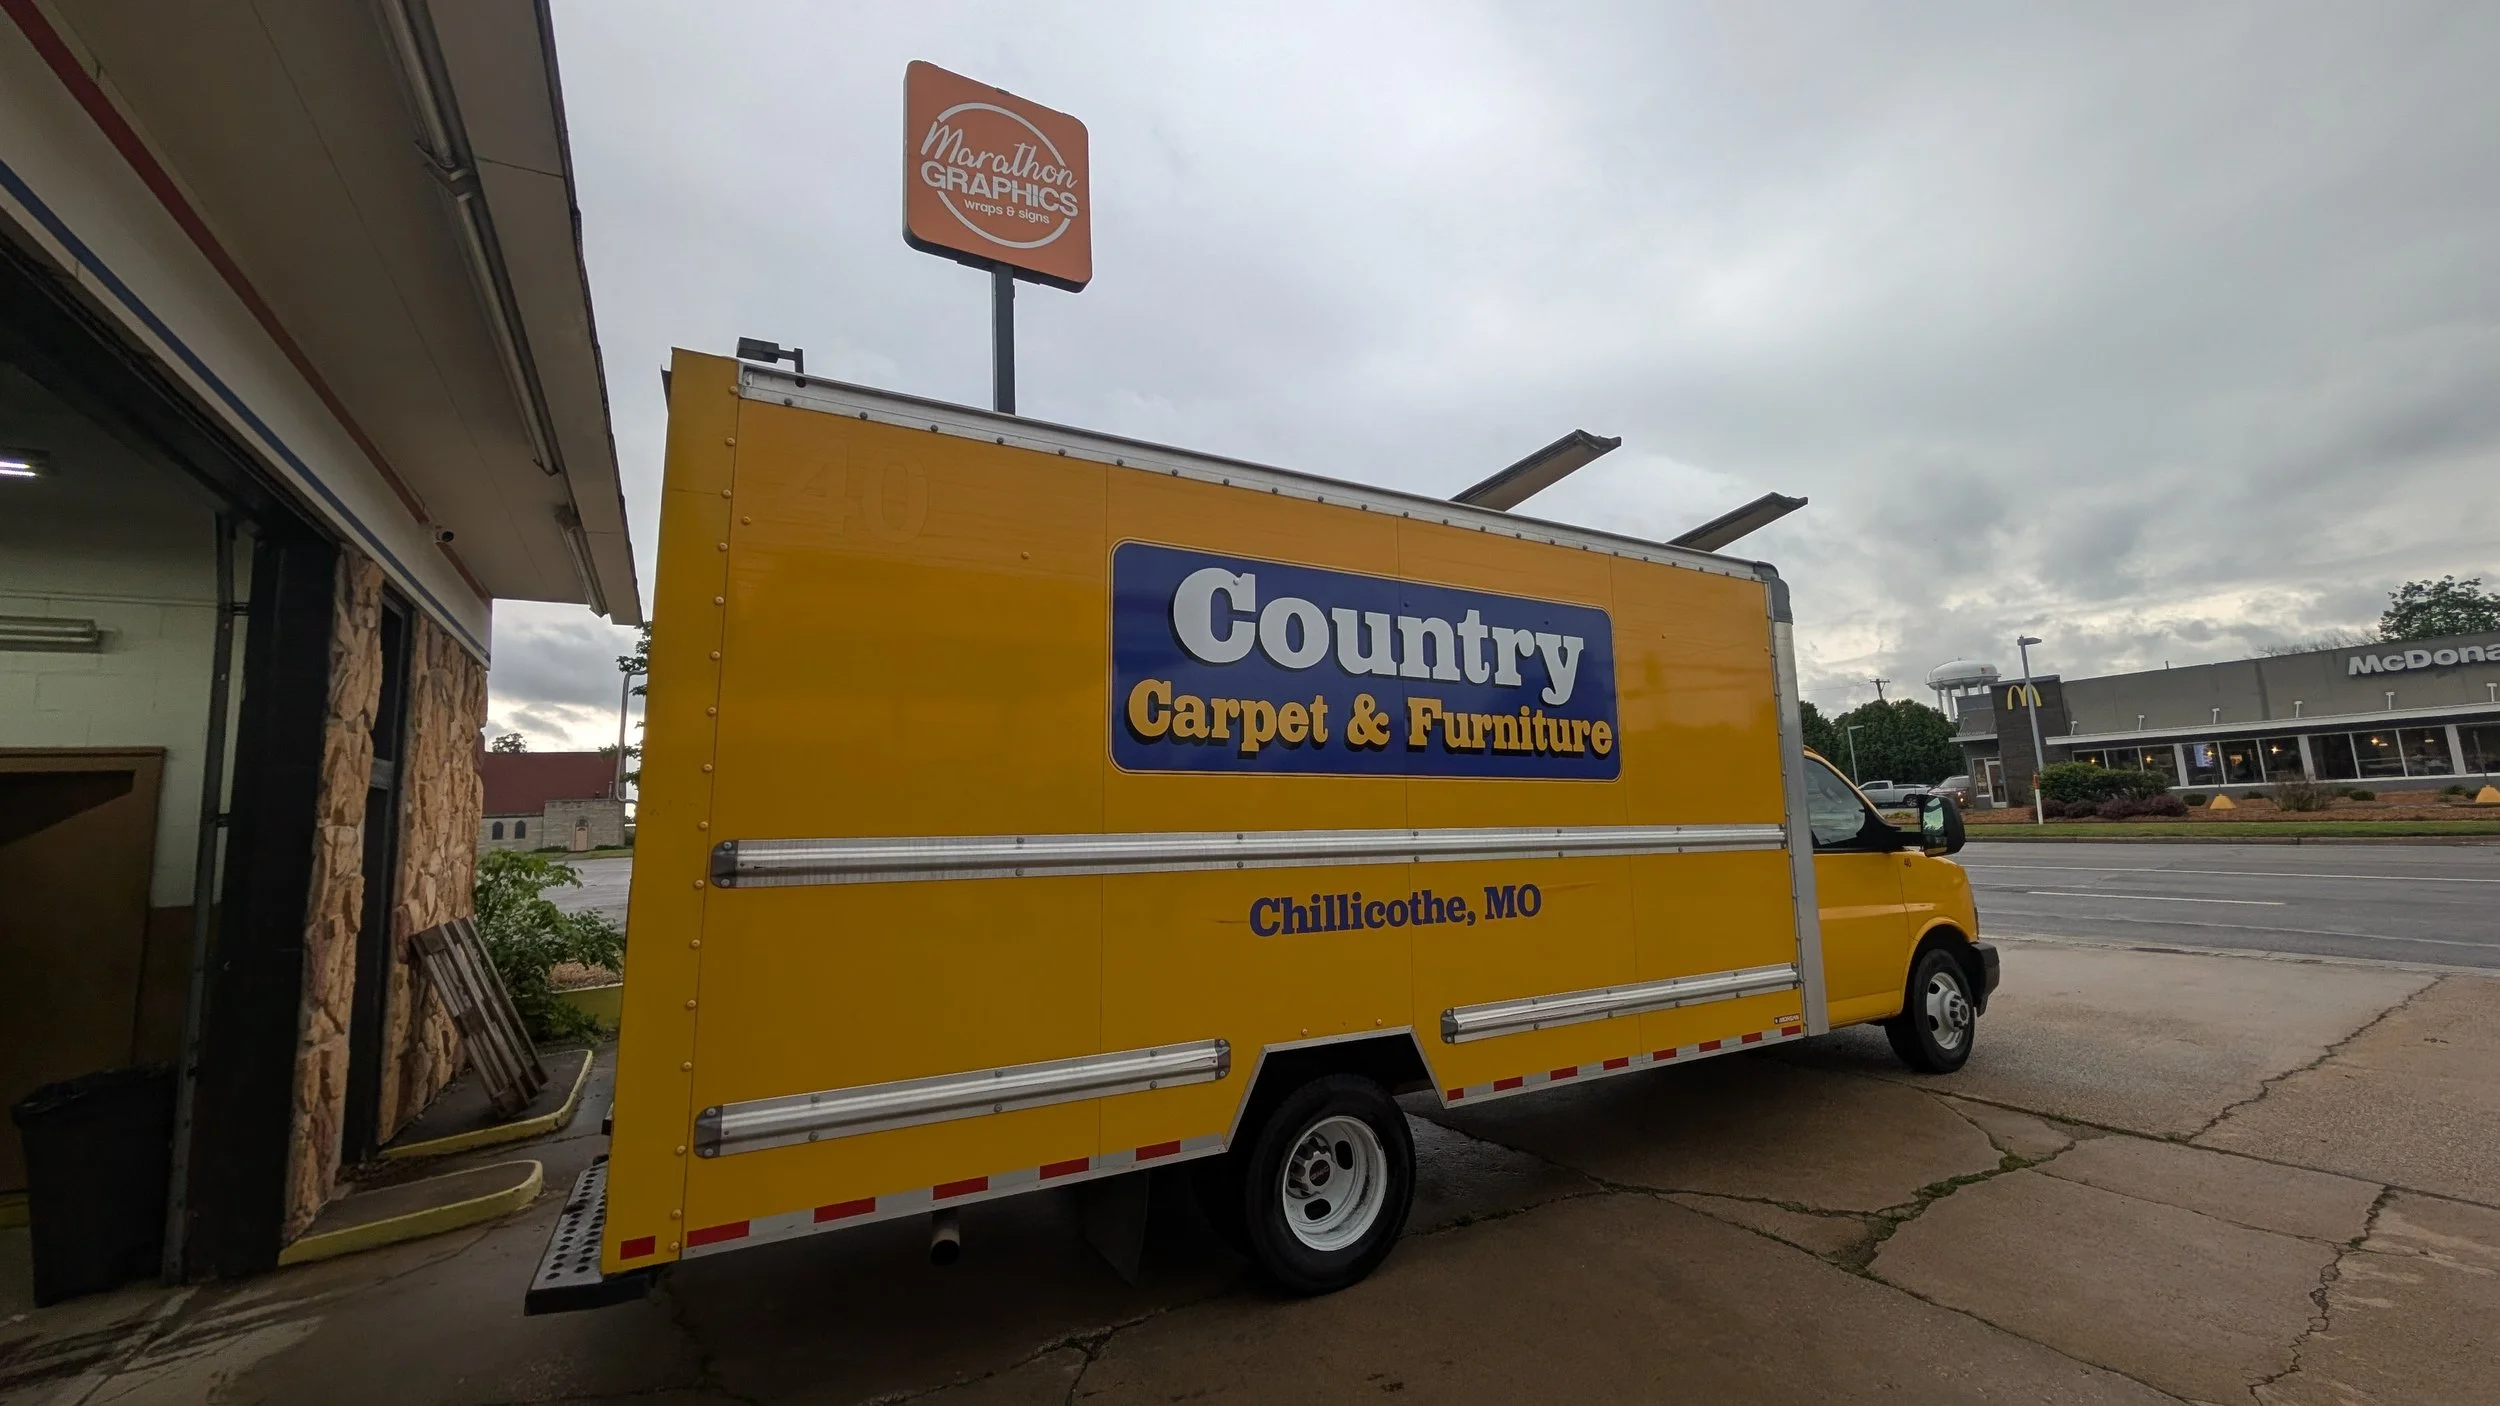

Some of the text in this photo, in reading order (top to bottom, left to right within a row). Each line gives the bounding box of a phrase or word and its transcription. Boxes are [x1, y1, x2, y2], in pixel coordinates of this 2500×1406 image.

[920, 120, 1078, 189] Marathon
[920, 160, 1079, 217] GRAPHICS
[964, 199, 1050, 224] wraps & signs
[1173, 567, 1584, 706] Country
[1128, 678, 1613, 756] Carpet & Furniture
[1249, 883, 1542, 937] Chillicothe, MO
